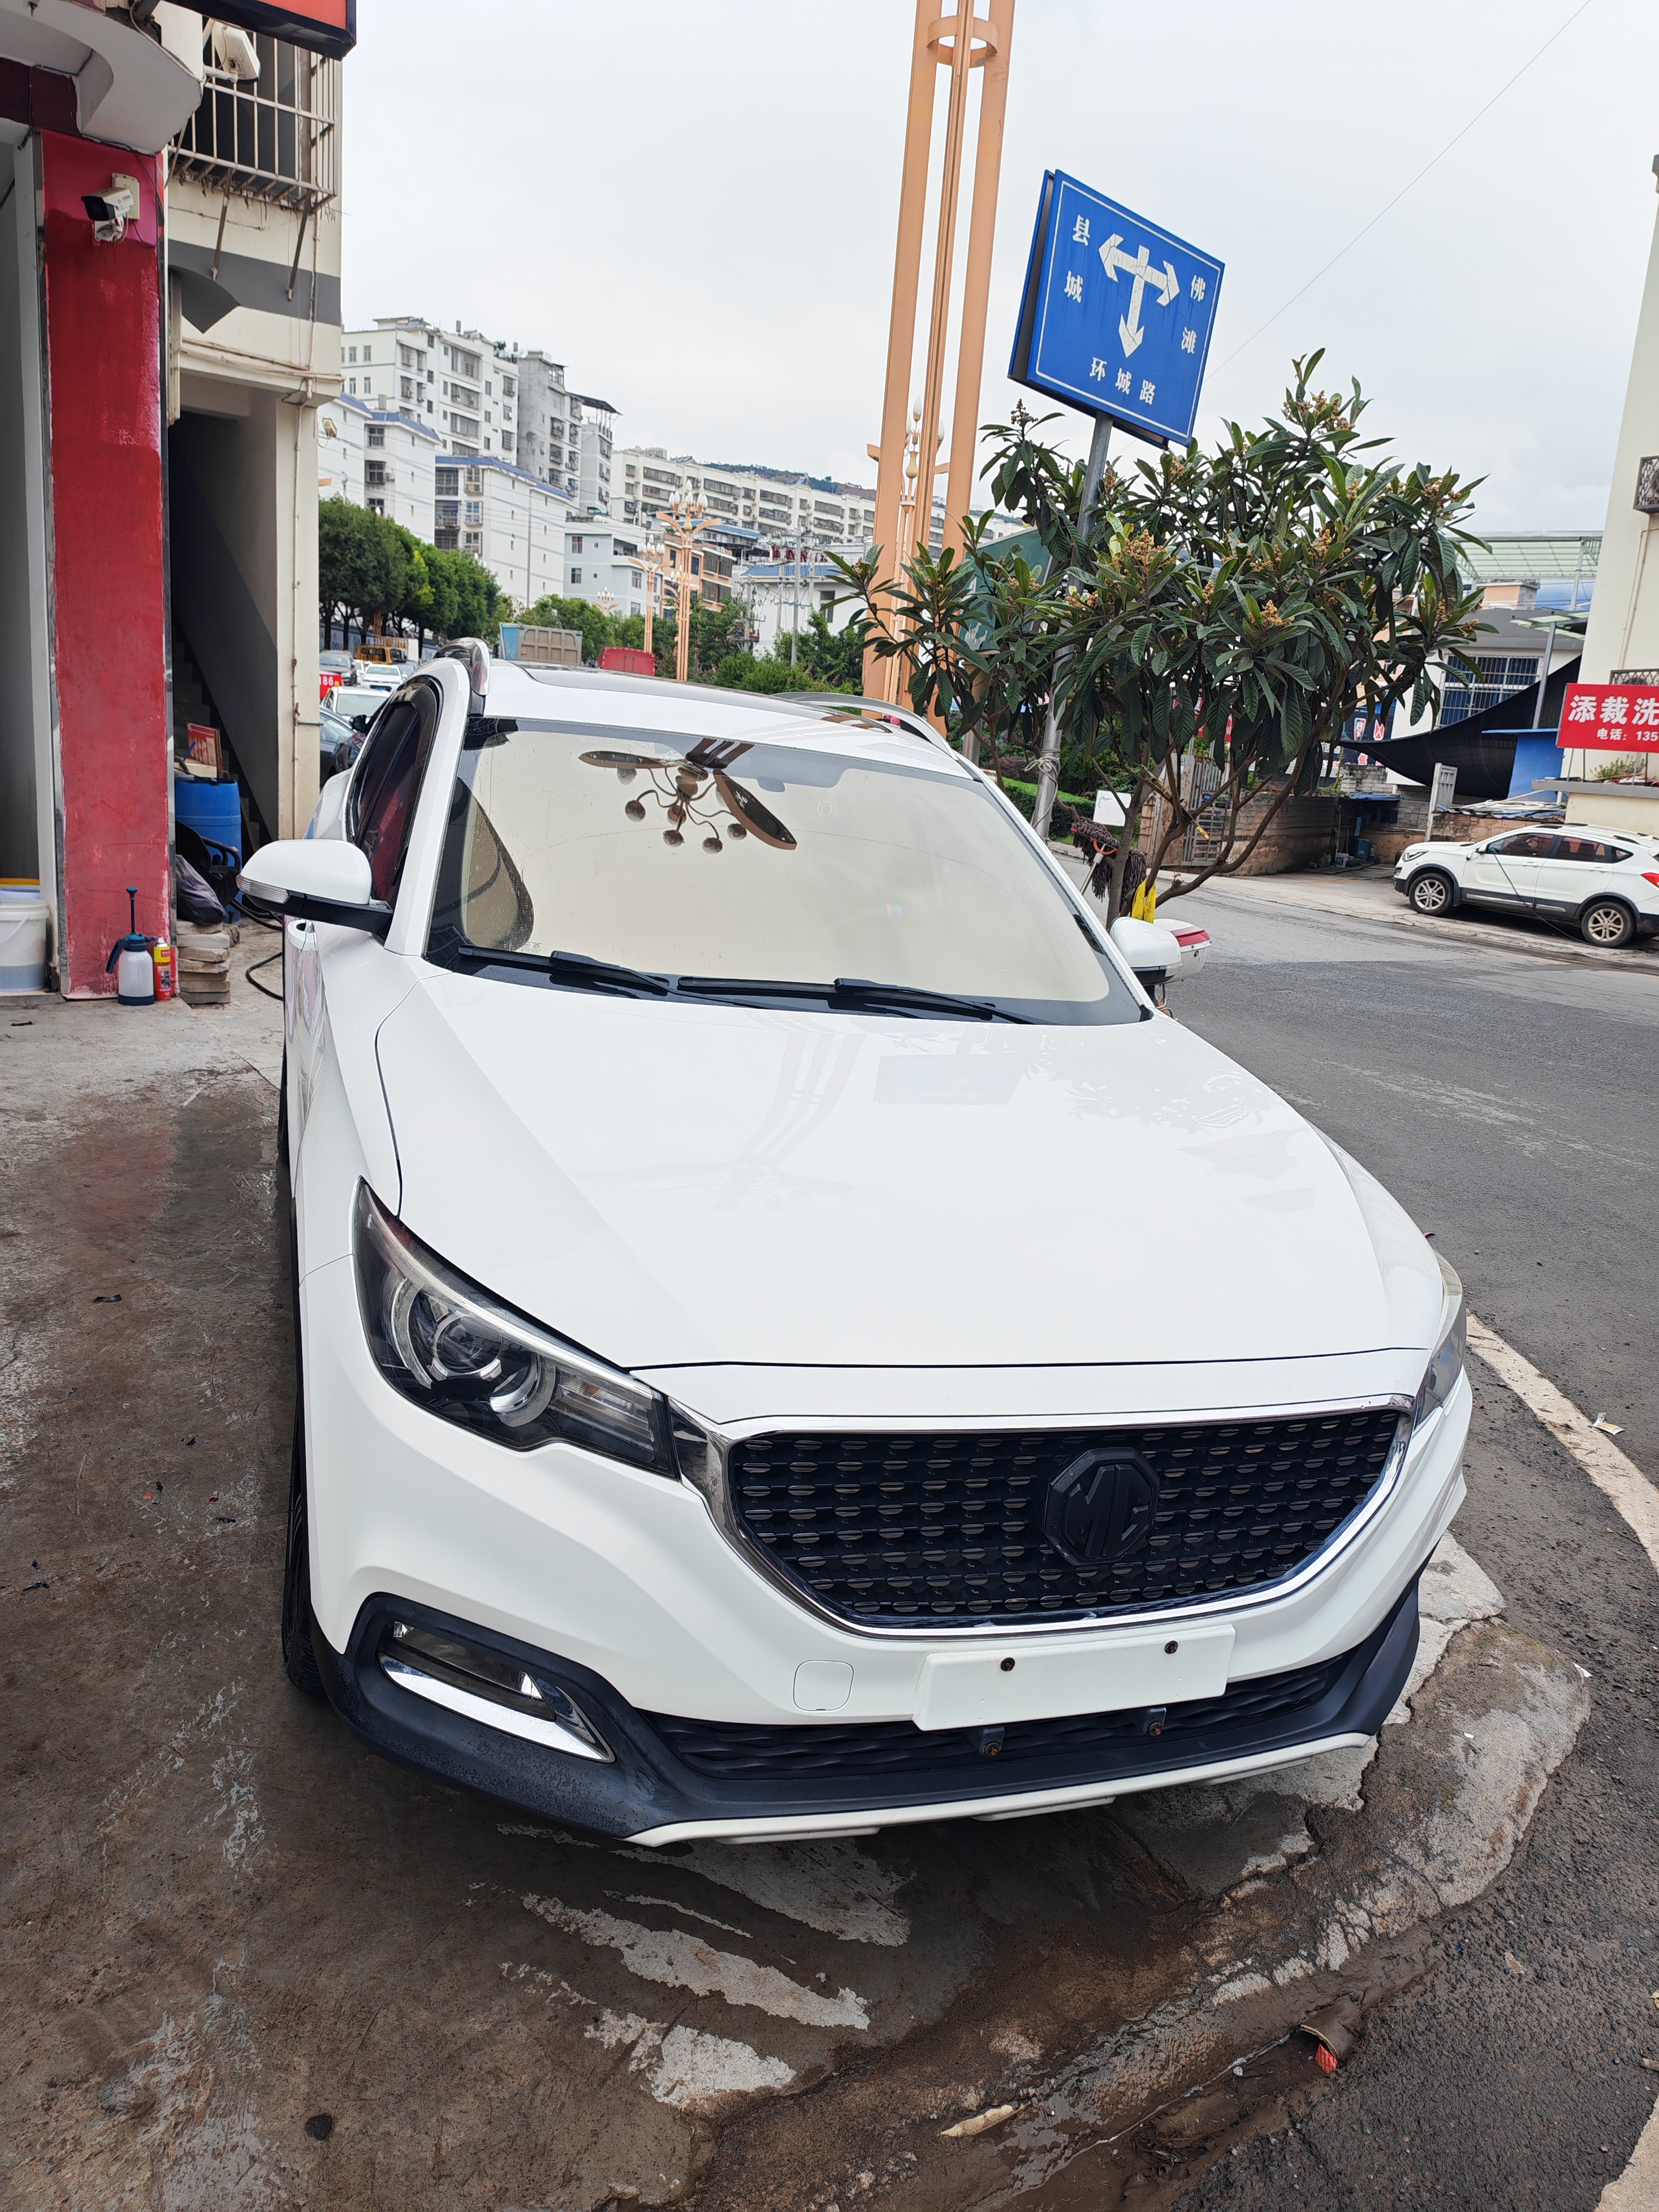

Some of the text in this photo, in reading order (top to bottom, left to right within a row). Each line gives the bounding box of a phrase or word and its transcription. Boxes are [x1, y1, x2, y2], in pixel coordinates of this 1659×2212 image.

[1064, 214, 1091, 303] 县城
[1181, 274, 1206, 355] 佛滩
[1089, 356, 1156, 405] 环城路
[1064, 1463, 1152, 1558] MG
